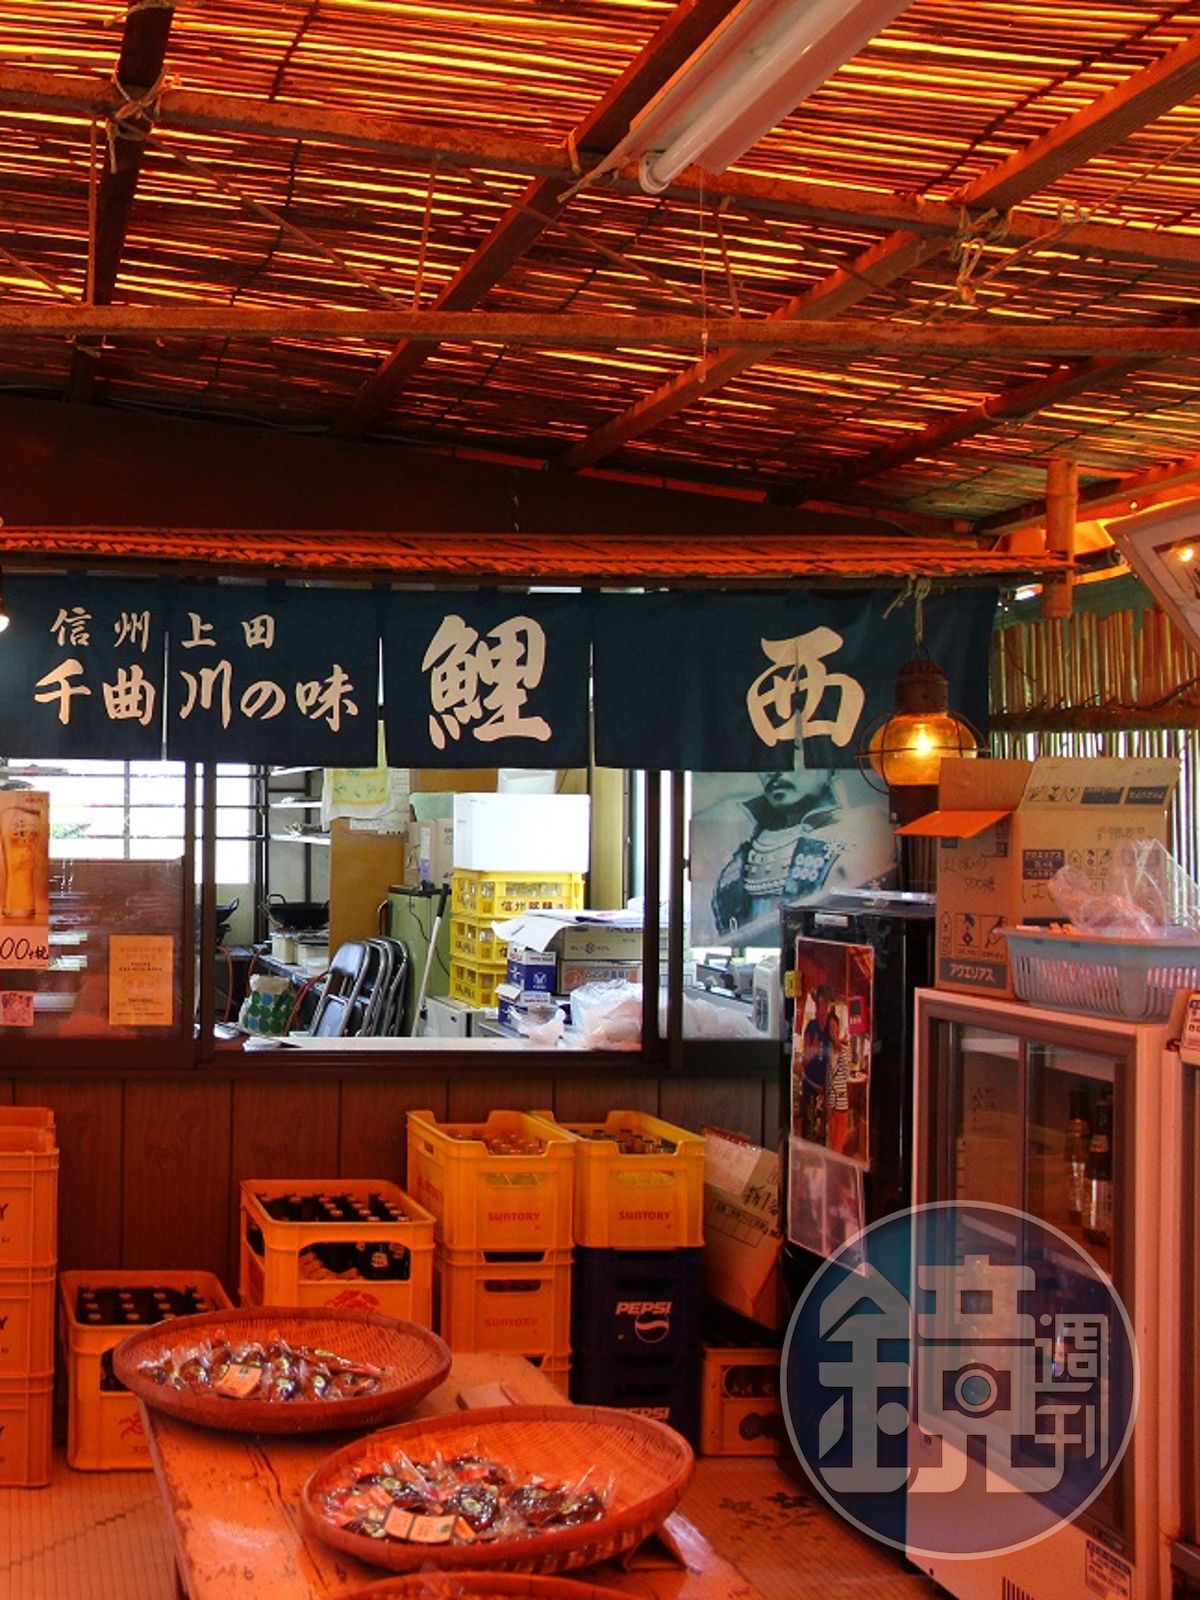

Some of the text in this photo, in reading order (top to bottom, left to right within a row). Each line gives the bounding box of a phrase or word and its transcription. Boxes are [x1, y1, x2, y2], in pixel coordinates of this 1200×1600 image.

[50, 606, 276, 653] 信州上田
[34, 658, 359, 733] 千曲川の味
[488, 1211, 540, 1221] SUNTORY
[618, 1210, 671, 1221] SUNTORY
[615, 1301, 671, 1316] PEPSI
[485, 1317, 538, 1328] SUNTORY
[616, 1406, 671, 1420] EPSI
